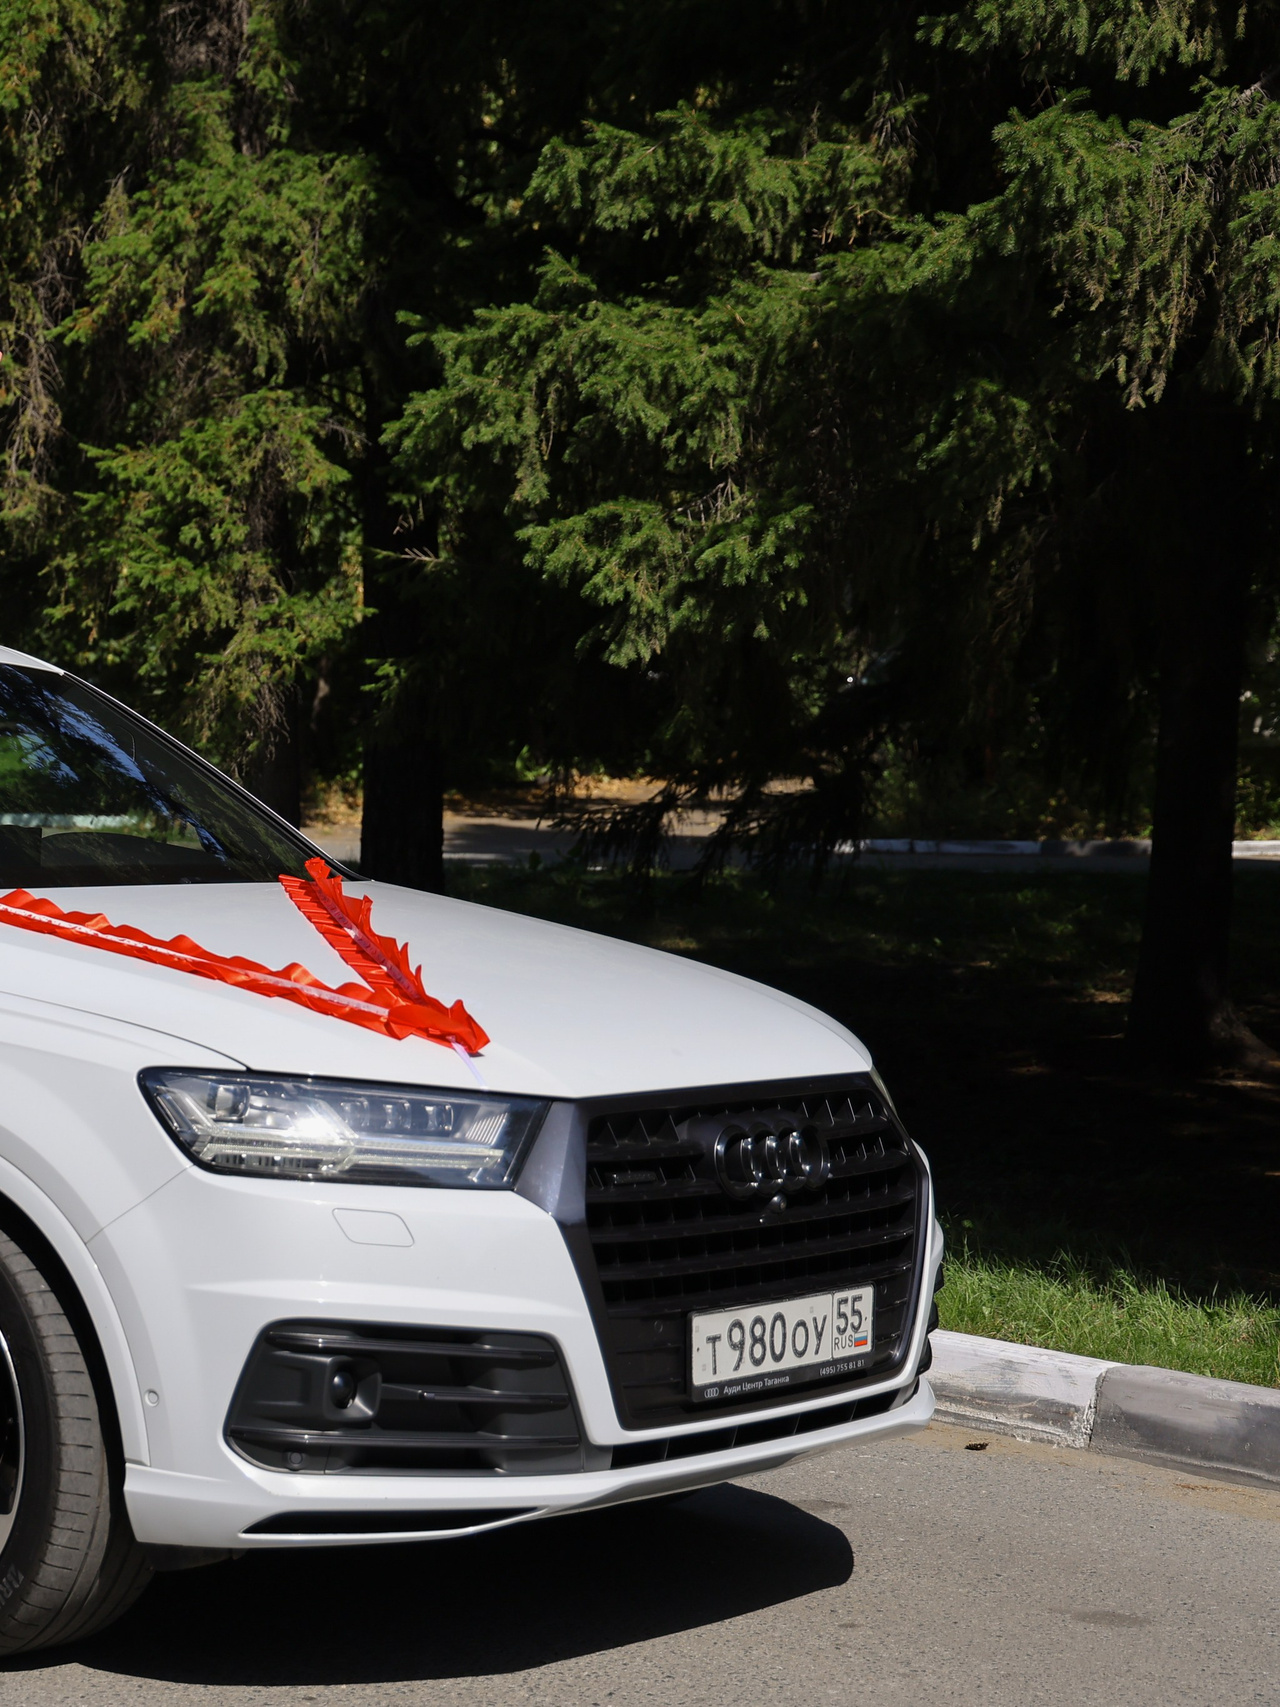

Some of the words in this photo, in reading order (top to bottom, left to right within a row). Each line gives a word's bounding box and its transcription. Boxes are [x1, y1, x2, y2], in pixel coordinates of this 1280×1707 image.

[835, 1294, 863, 1336] 55
[834, 1334, 854, 1351] RUS
[820, 1366, 836, 1377] (495)
[837, 1363, 848, 1373] 755
[849, 1361, 857, 1370] 81
[858, 1359, 865, 1368] 81
[723, 1384, 742, 1396] Ауди
[743, 1380, 763, 1391] Центр
[764, 1375, 790, 1387] Таганка
